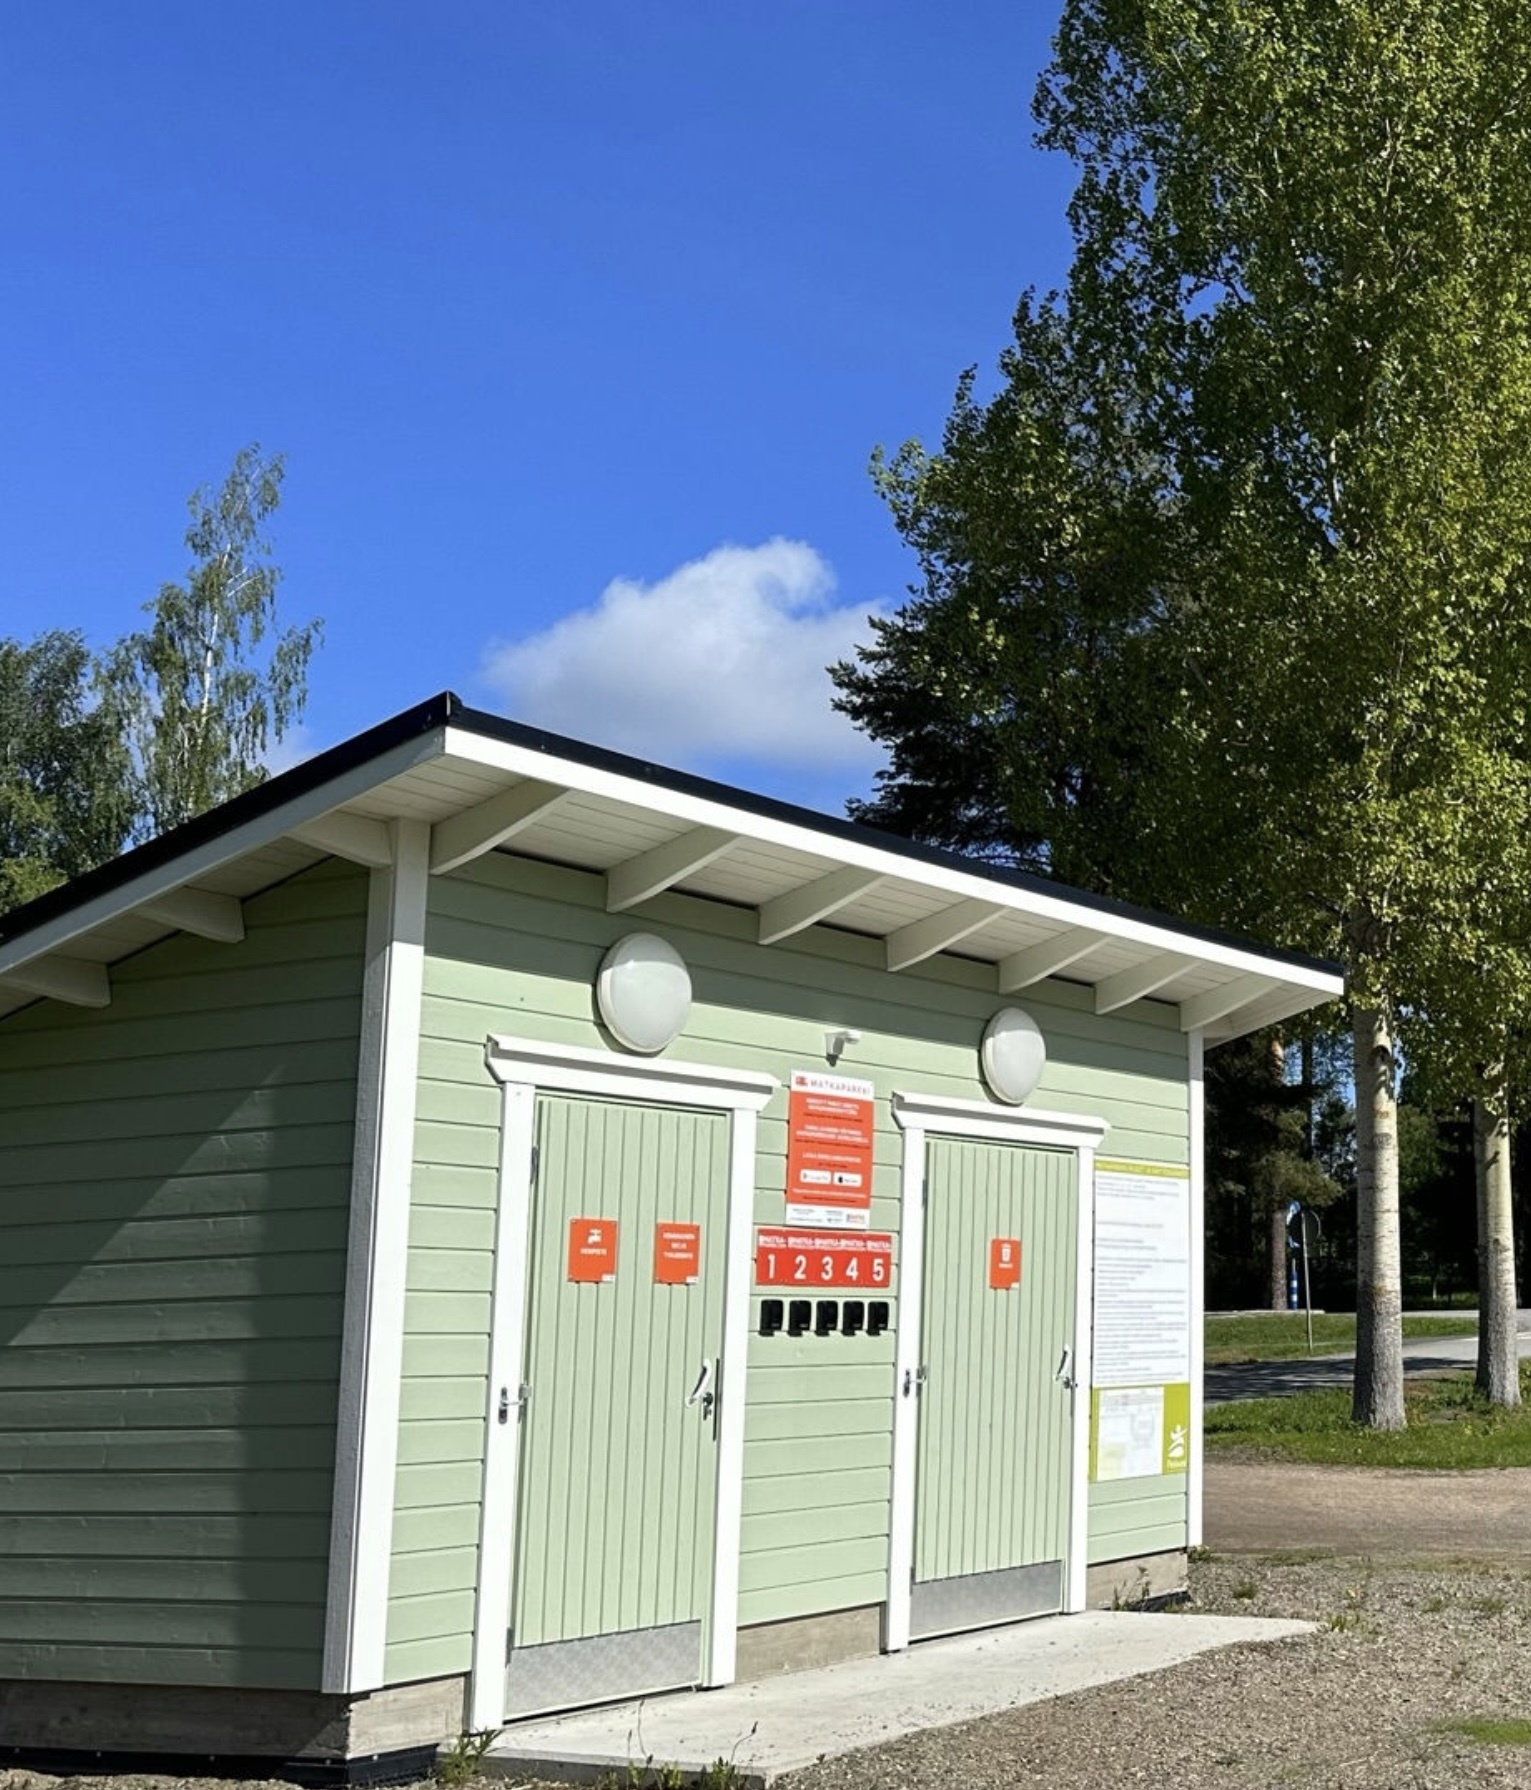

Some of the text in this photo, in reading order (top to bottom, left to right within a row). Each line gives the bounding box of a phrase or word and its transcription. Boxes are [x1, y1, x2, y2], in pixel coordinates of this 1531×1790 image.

[768, 1254, 884, 1281] 1 2 3 4 5
